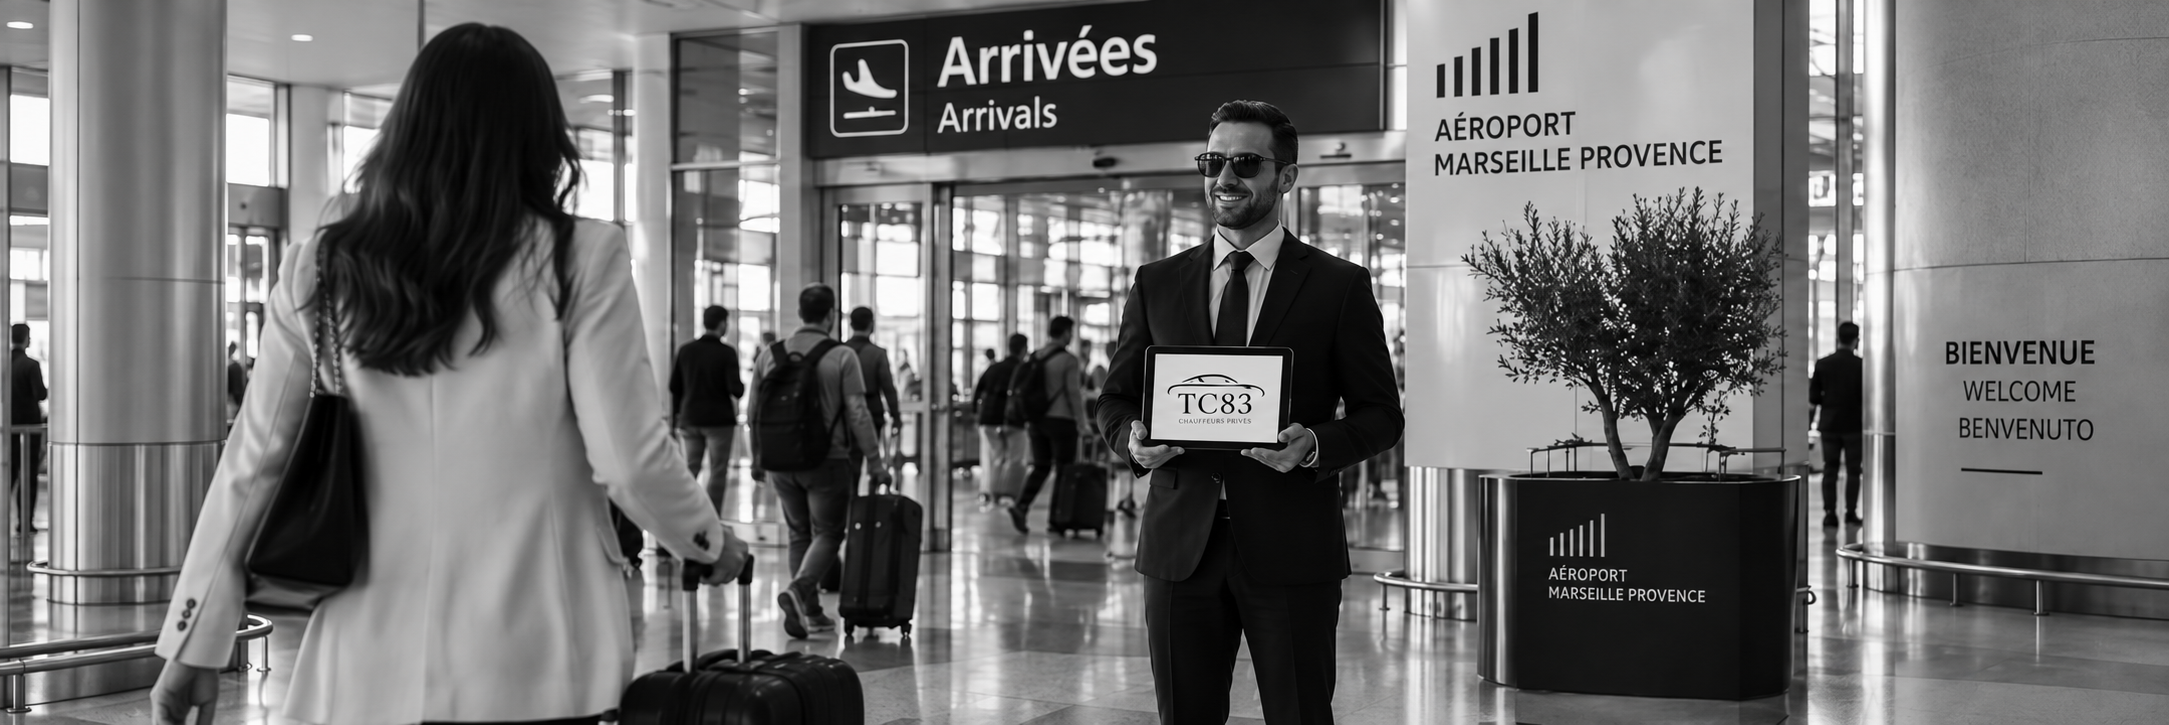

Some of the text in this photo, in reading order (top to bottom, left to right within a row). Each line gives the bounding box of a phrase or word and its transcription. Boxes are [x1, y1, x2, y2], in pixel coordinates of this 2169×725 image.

[937, 25, 1157, 87] Arrivées
[938, 96, 1058, 134] Arrivals
[1434, 111, 1576, 142] AÉROPORT
[1434, 139, 1723, 176] MARSEILLE PROVENCE
[1945, 340, 2095, 365] BIENVENUE
[1963, 380, 2076, 402] WELCOME
[1177, 393, 1252, 415] TC83
[1178, 417, 1225, 425] CHAUFFEURS
[1959, 417, 2094, 441] BENVENUTO
[1548, 565, 1628, 582] AÉROPORT
[1548, 586, 1706, 603] MARSEILLE PROVENCE
